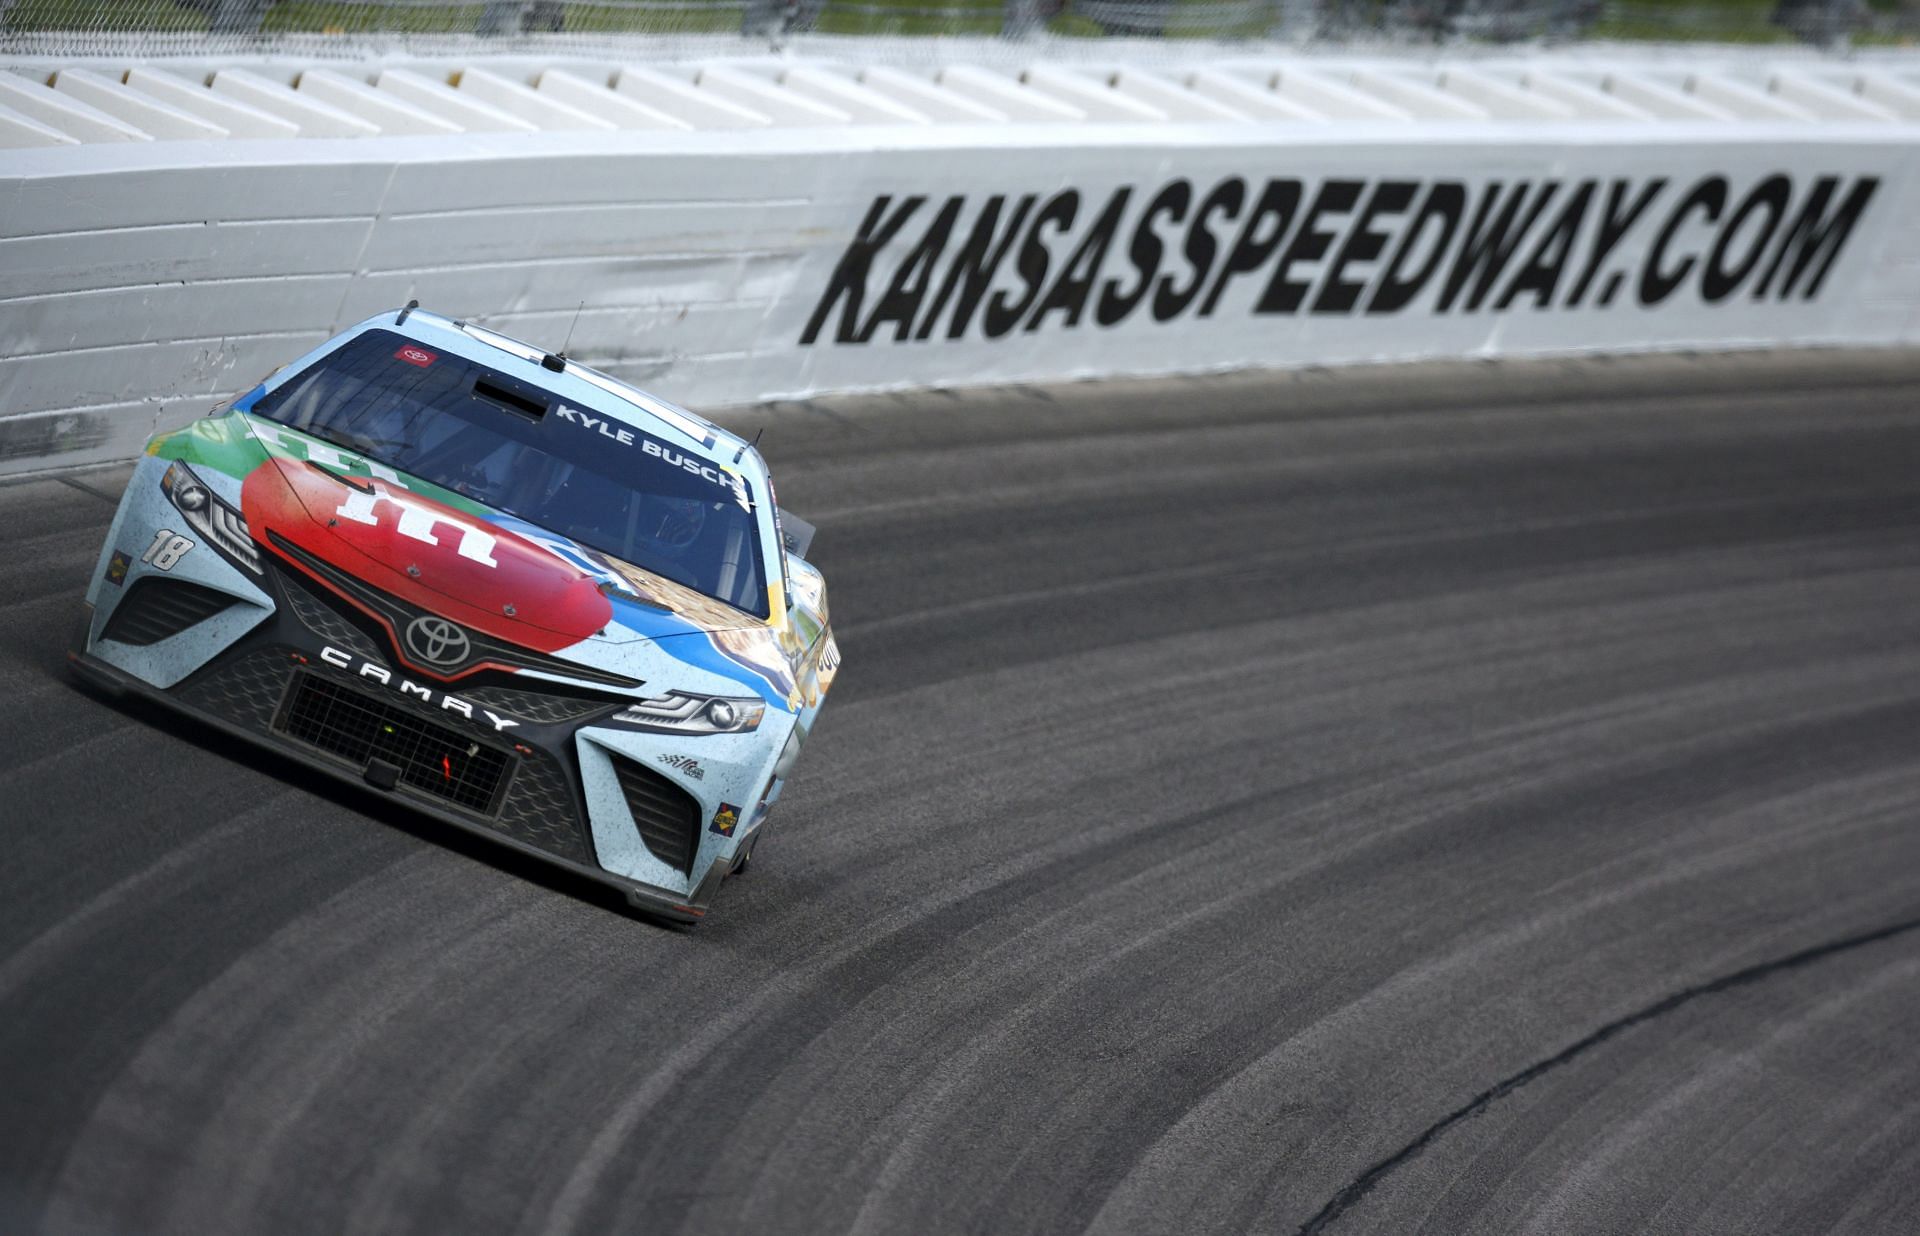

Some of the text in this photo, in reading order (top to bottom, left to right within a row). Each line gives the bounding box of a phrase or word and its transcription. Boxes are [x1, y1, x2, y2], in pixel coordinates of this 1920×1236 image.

[798, 173, 1882, 345] KANSASSPEEDWAY.COM
[556, 404, 745, 490] KYLE BUSCH
[140, 528, 196, 571] 18
[320, 646, 520, 731] CAMRY
